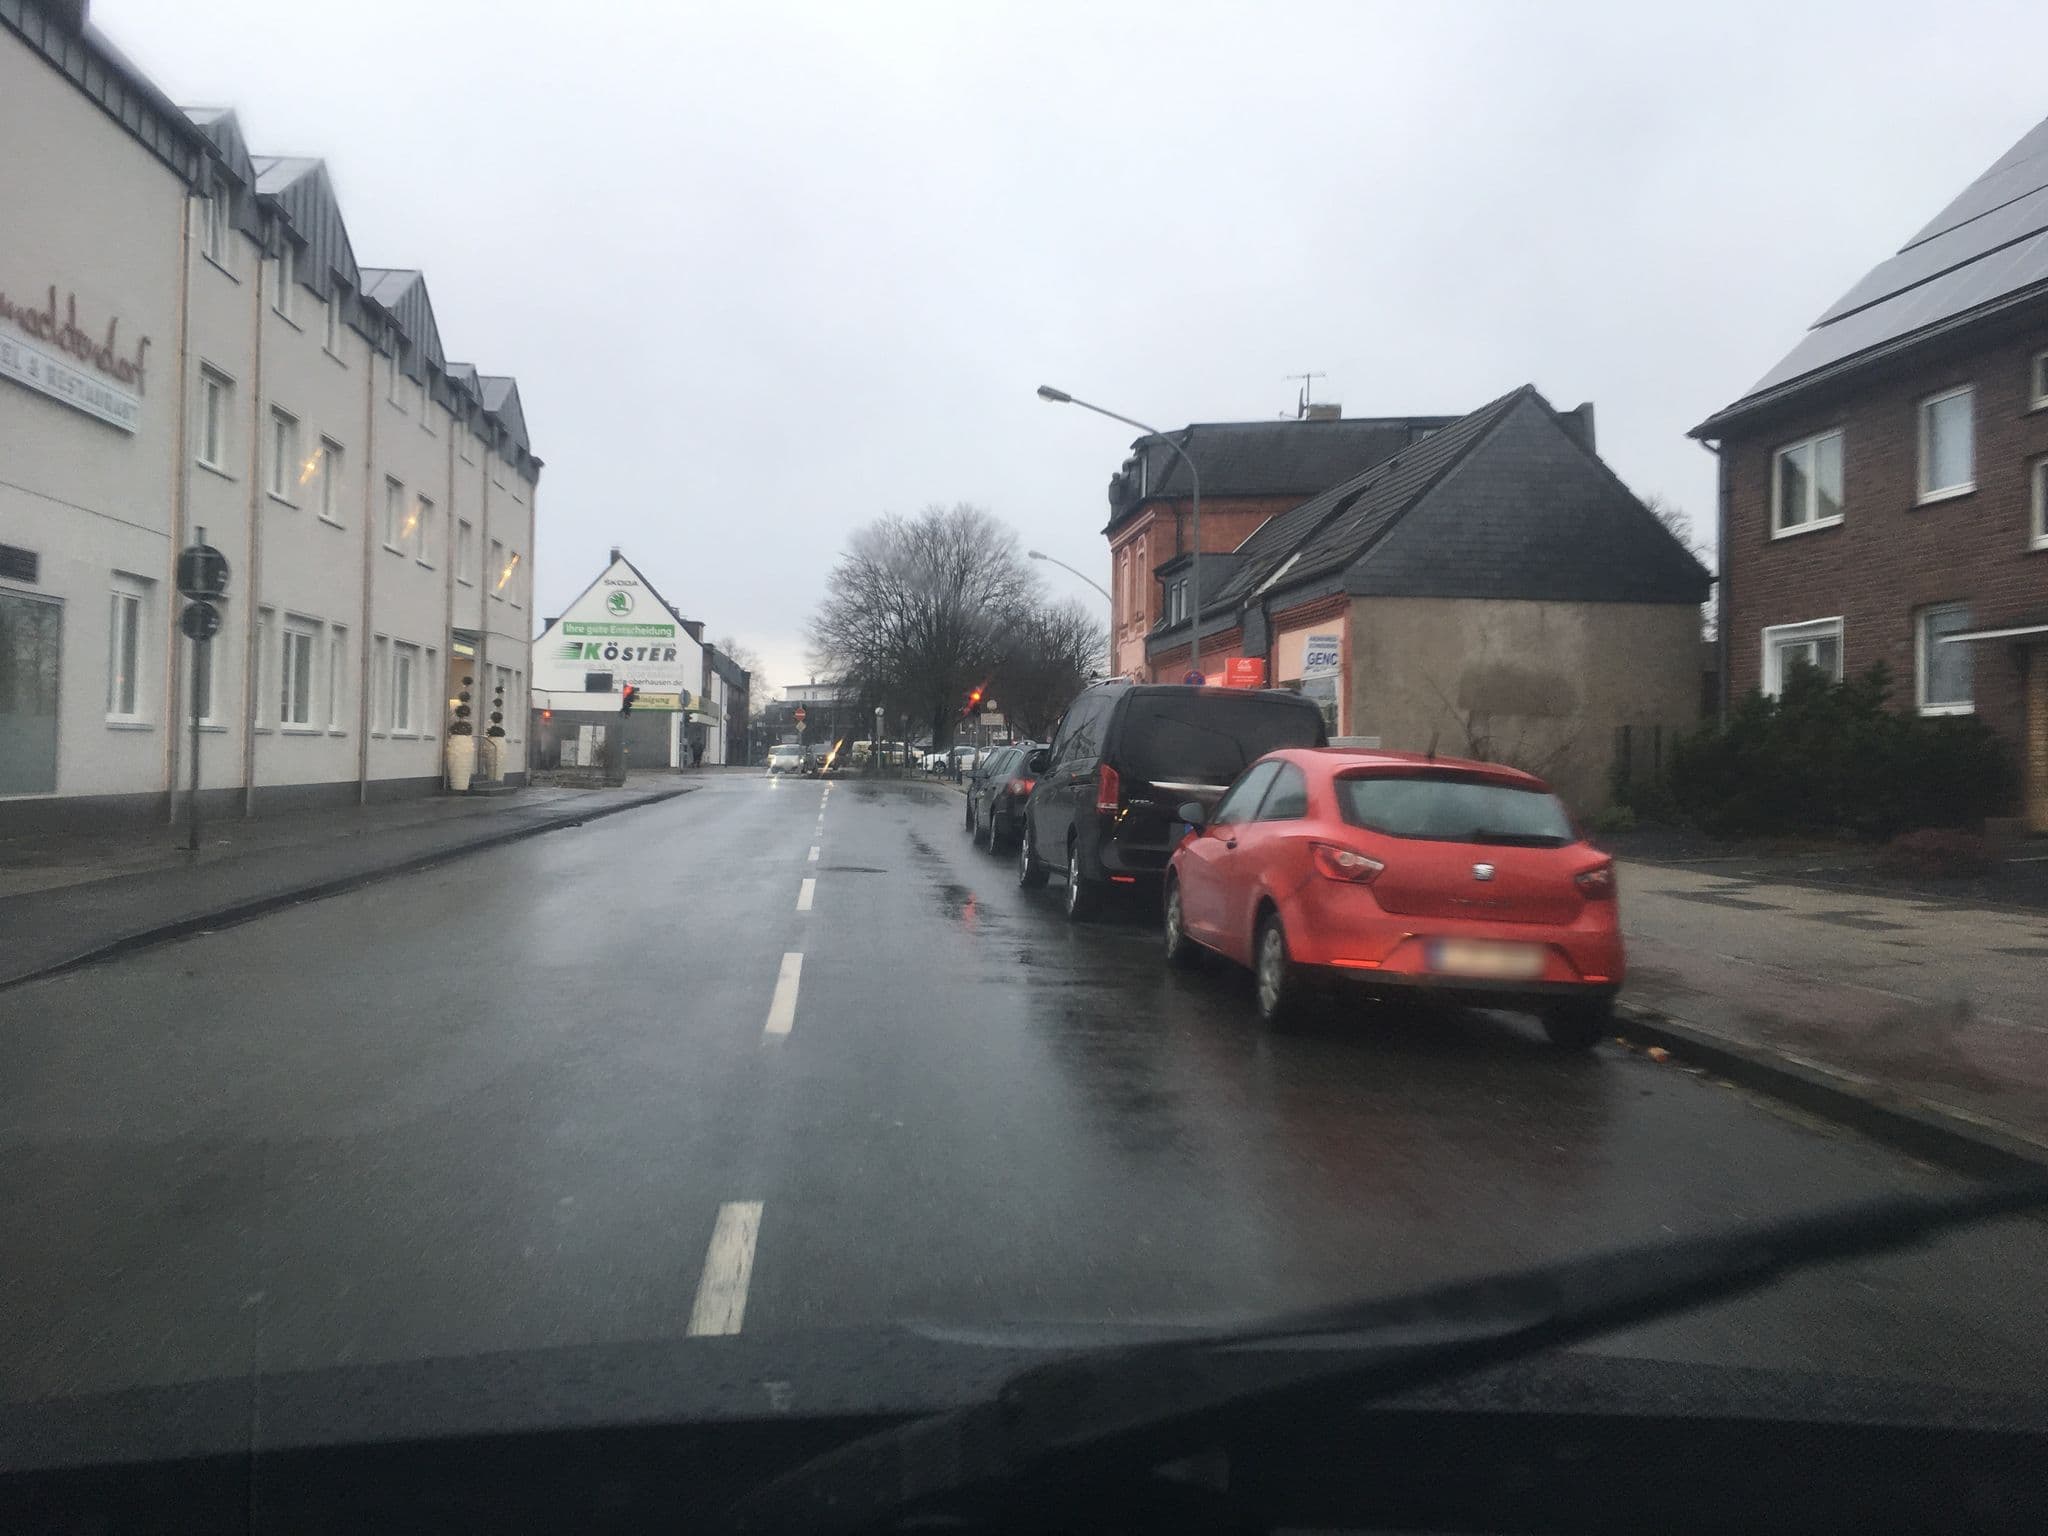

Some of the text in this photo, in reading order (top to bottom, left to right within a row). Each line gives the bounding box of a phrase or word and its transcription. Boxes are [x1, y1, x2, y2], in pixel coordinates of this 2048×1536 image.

[566, 623, 673, 637] Ihre gute Entscheidung
[584, 641, 677, 661] KÖSTER
